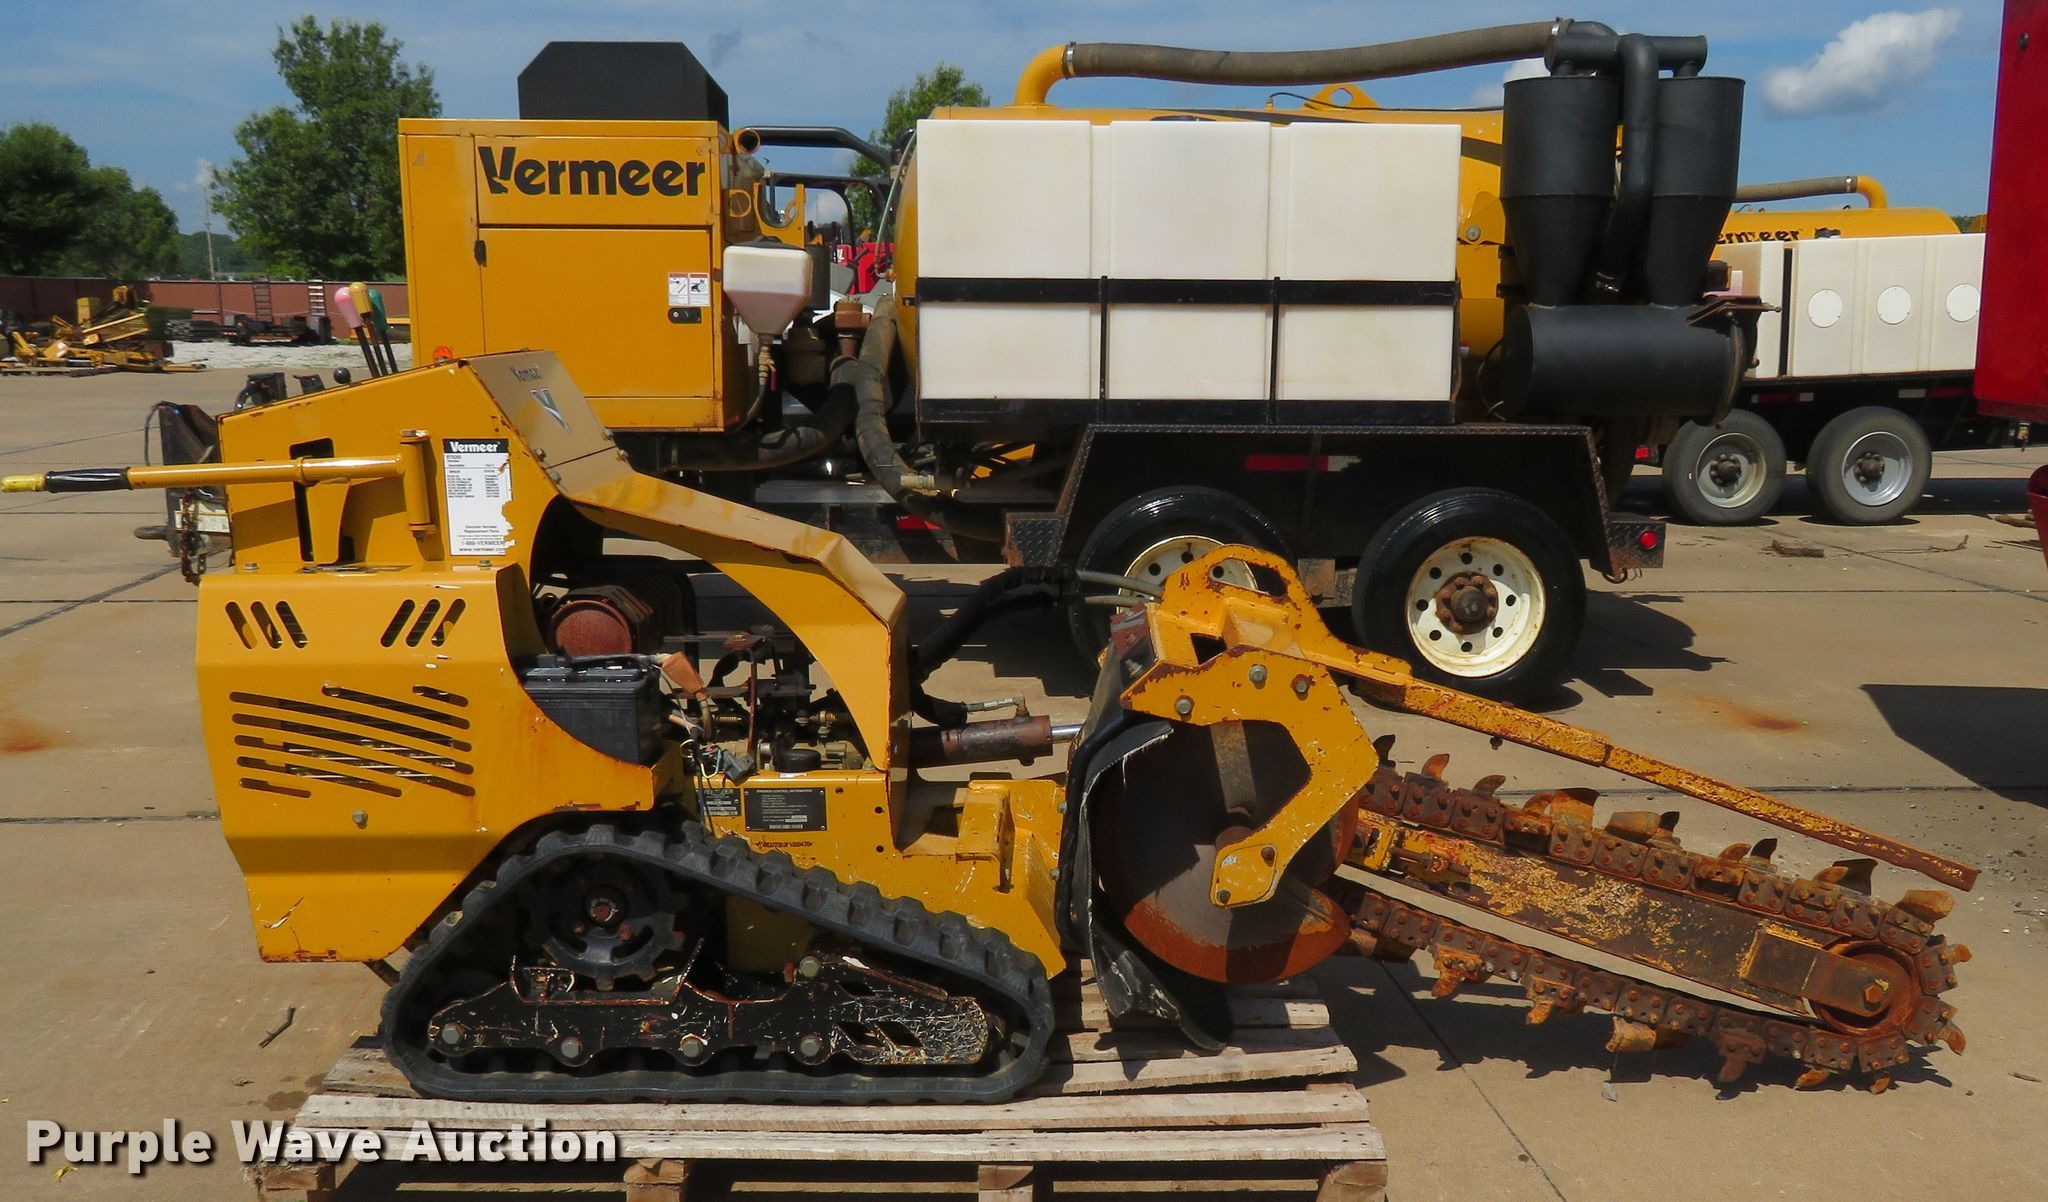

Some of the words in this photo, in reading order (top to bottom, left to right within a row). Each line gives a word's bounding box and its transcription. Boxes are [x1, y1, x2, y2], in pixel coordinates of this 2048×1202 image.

[478, 146, 706, 197] Vermeer
[1716, 230, 1801, 245] ermeer
[449, 441, 499, 453] Vermeer
